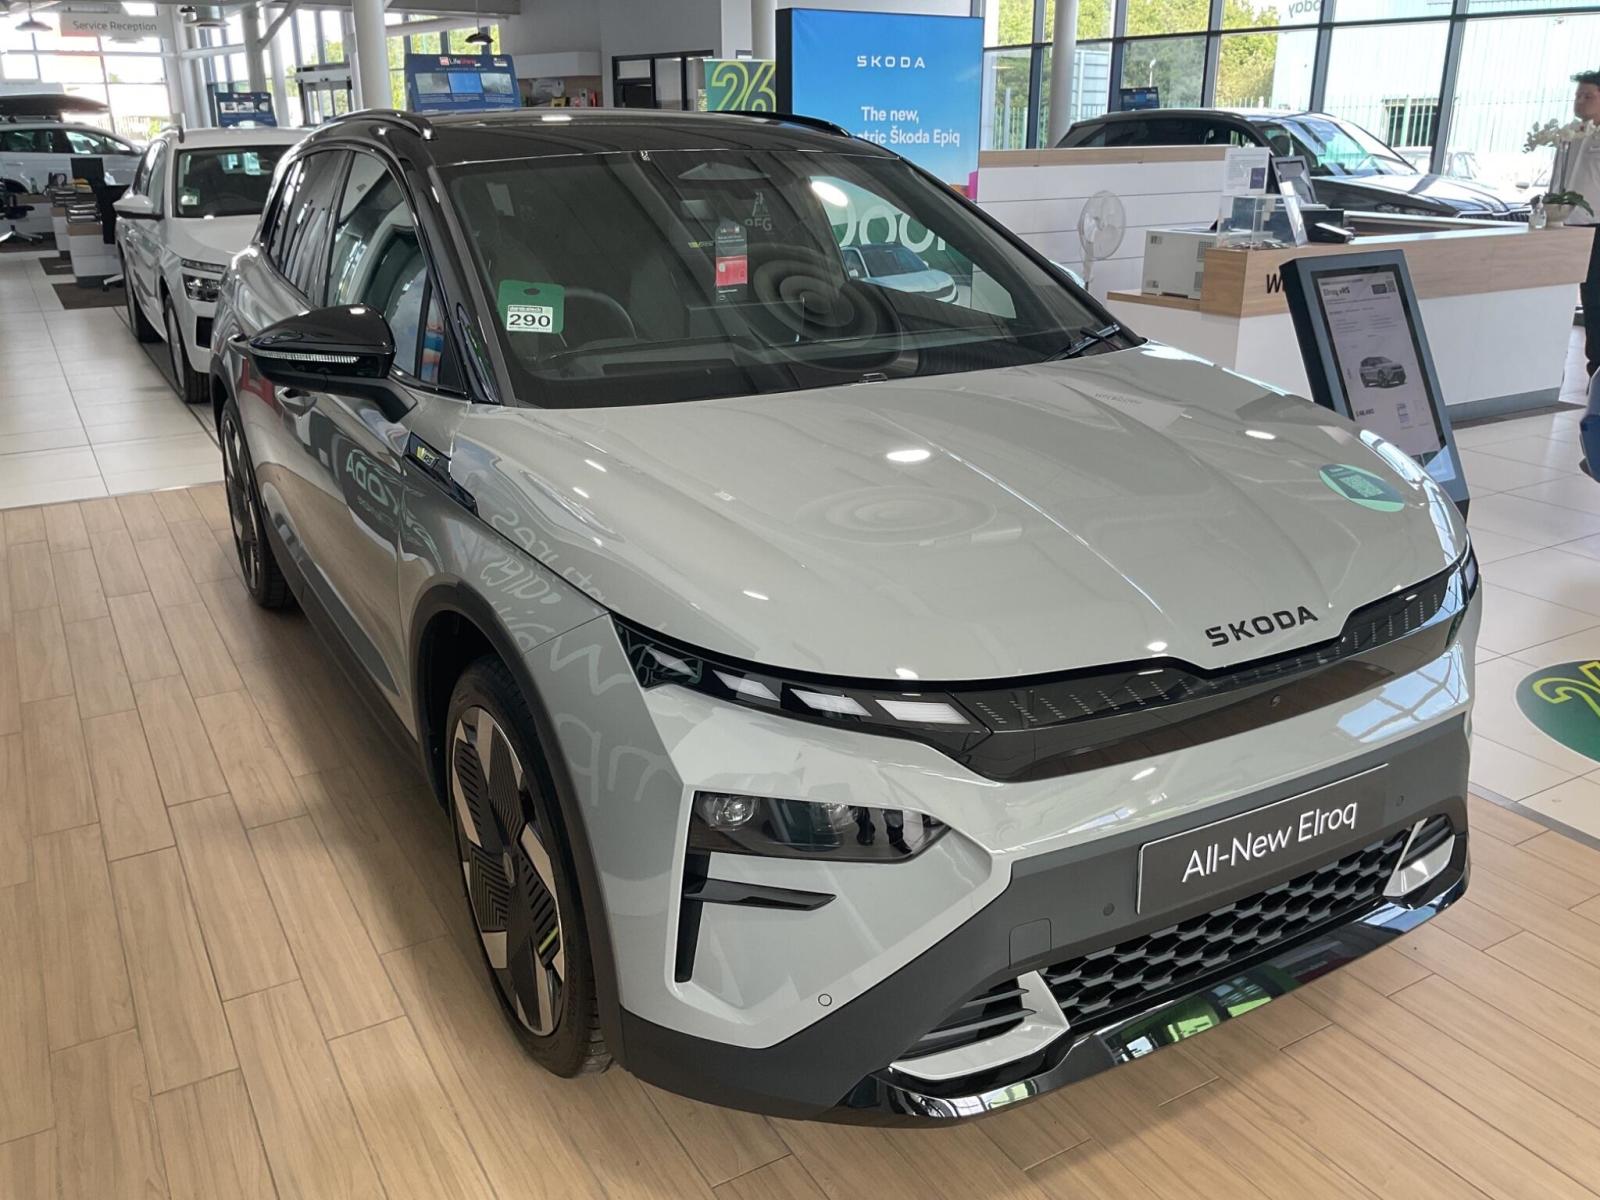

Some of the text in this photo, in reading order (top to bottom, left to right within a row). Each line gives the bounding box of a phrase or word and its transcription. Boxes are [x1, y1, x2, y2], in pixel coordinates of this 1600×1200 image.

[72, 21, 157, 32] Service Reception
[856, 55, 926, 69] SKODA
[861, 106, 920, 124] The new,
[890, 125, 930, 145] Škoda
[933, 129, 961, 148] Epiq
[509, 313, 551, 328] 290
[1204, 605, 1319, 648] SKODA
[1181, 801, 1358, 883] All-New Elroq
